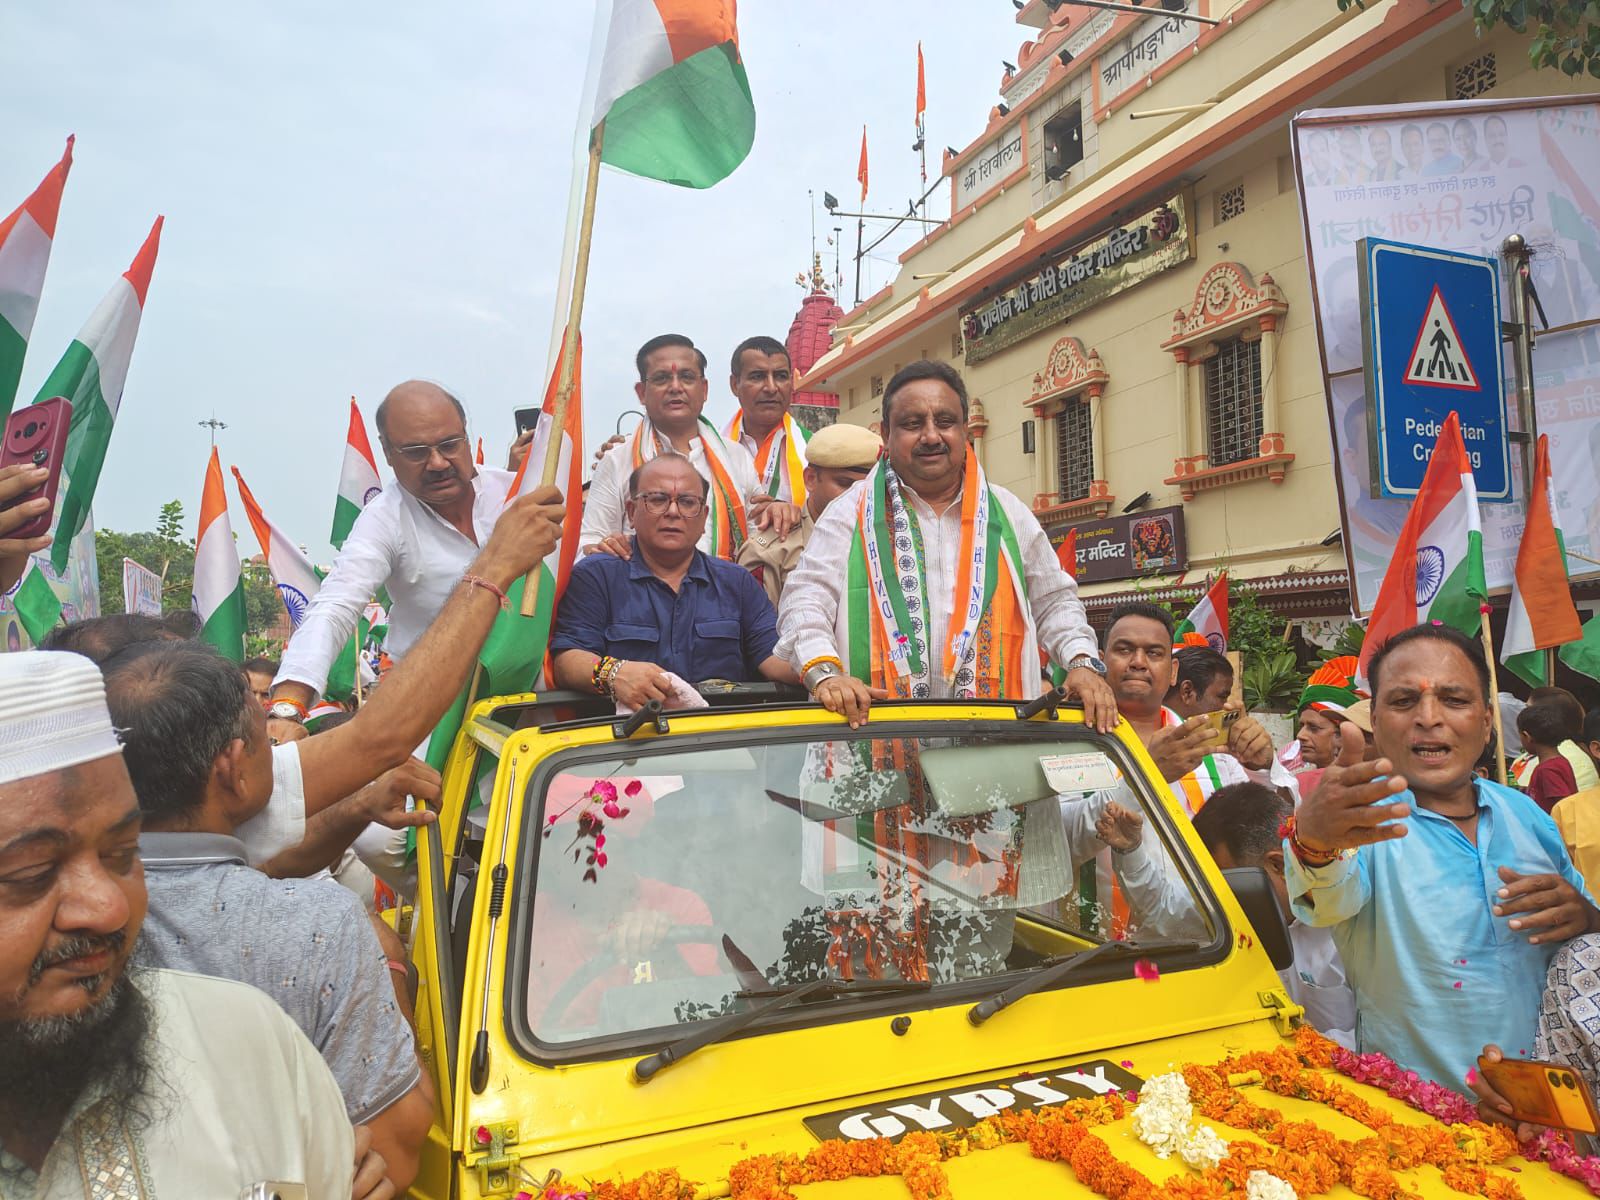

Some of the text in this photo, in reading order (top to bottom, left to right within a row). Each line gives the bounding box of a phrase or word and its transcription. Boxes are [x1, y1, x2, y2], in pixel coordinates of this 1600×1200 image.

[963, 136, 1022, 191] श्री शिवालय
[980, 296, 1012, 336] प्राचीन
[1014, 281, 1030, 313] श्री
[1059, 254, 1095, 290] शंकर
[1413, 443, 1481, 469] Crng
[969, 488, 987, 621] JAI HIND
[838, 1066, 1122, 1140] GYPSY
